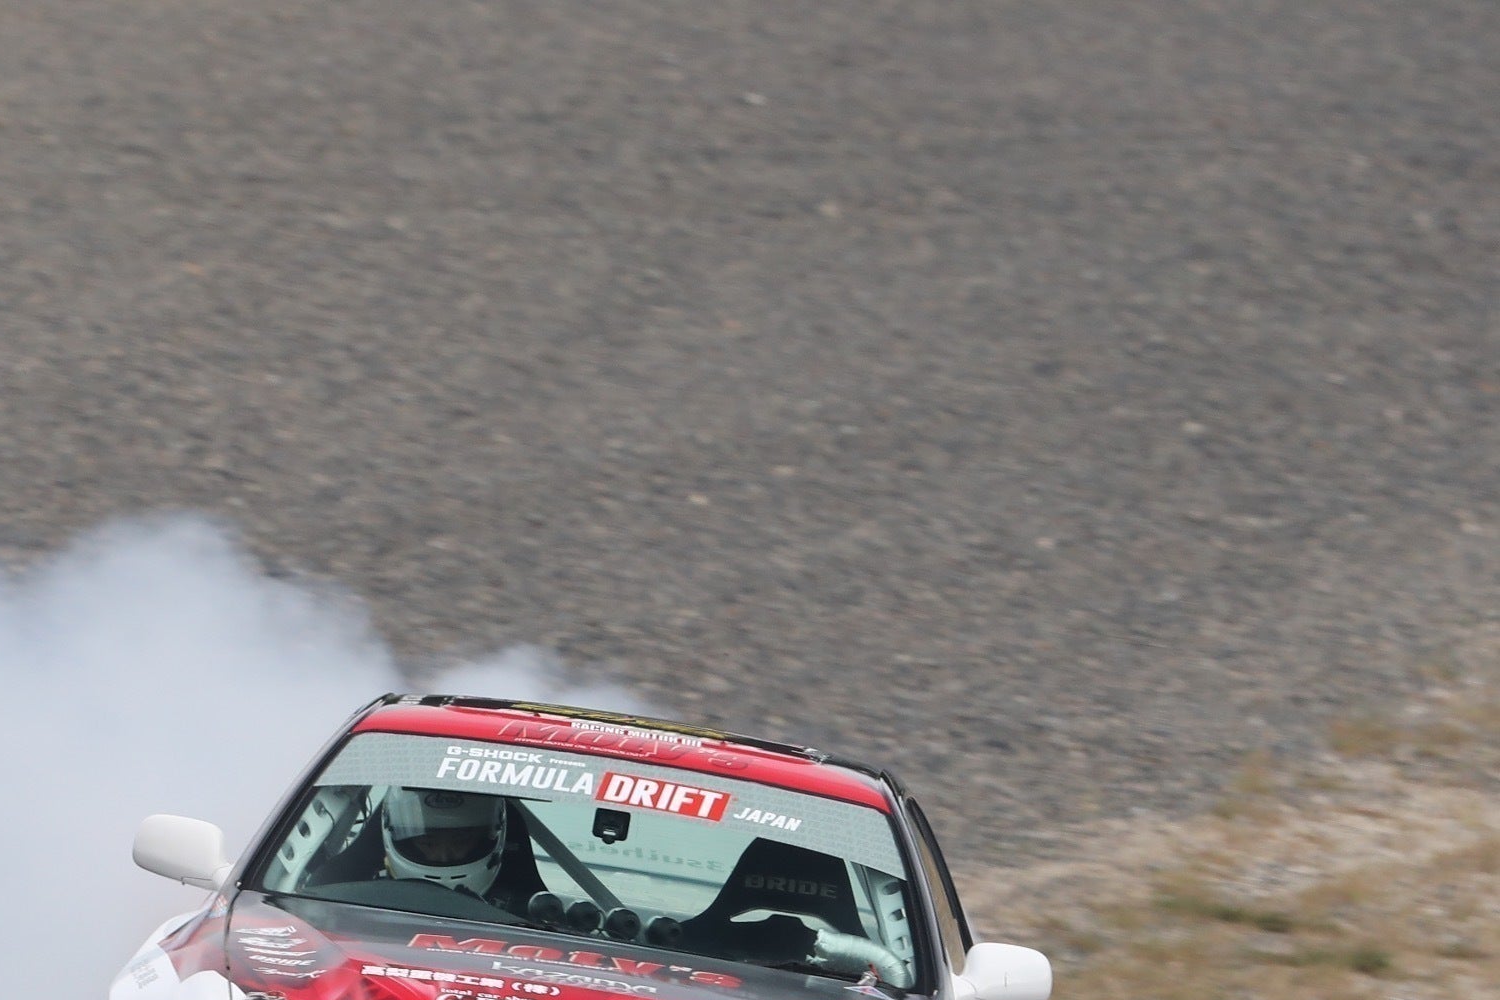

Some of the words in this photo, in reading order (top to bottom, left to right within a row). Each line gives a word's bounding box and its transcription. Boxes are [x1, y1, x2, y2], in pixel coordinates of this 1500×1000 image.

[446, 746, 543, 764] G-SHOCK
[436, 757, 594, 796] FORMULA
[603, 774, 724, 818] DRIFT
[733, 807, 802, 832] JAPAN
[744, 875, 838, 898] BRIDE
